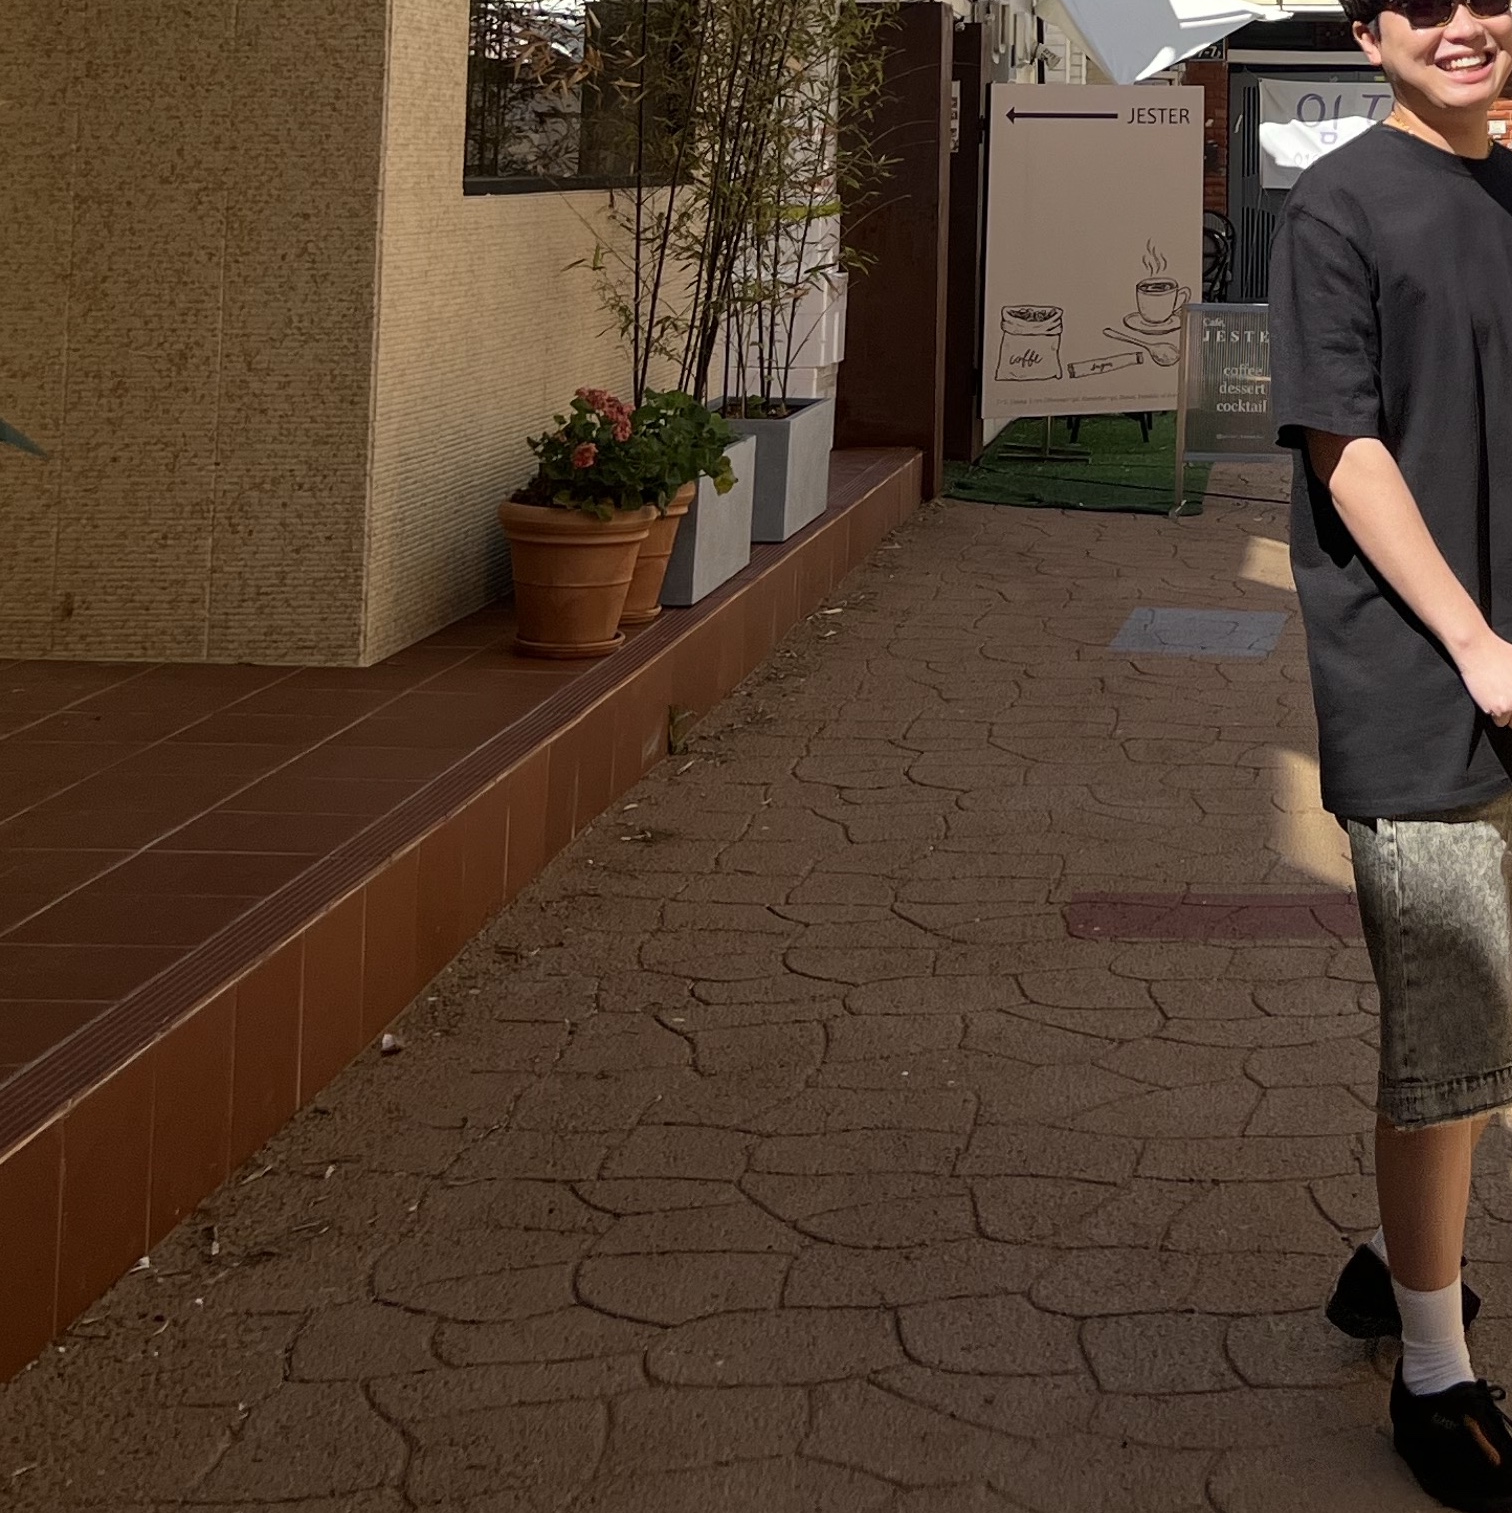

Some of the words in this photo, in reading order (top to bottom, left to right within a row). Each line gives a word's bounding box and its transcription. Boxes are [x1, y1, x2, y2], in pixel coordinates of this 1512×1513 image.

[1127, 107, 1190, 125] JESTER
[1203, 330, 1270, 344] JESTE
[1223, 362, 1263, 378] coffee
[1219, 380, 1266, 395] dessert
[1216, 398, 1268, 413] cocktail
